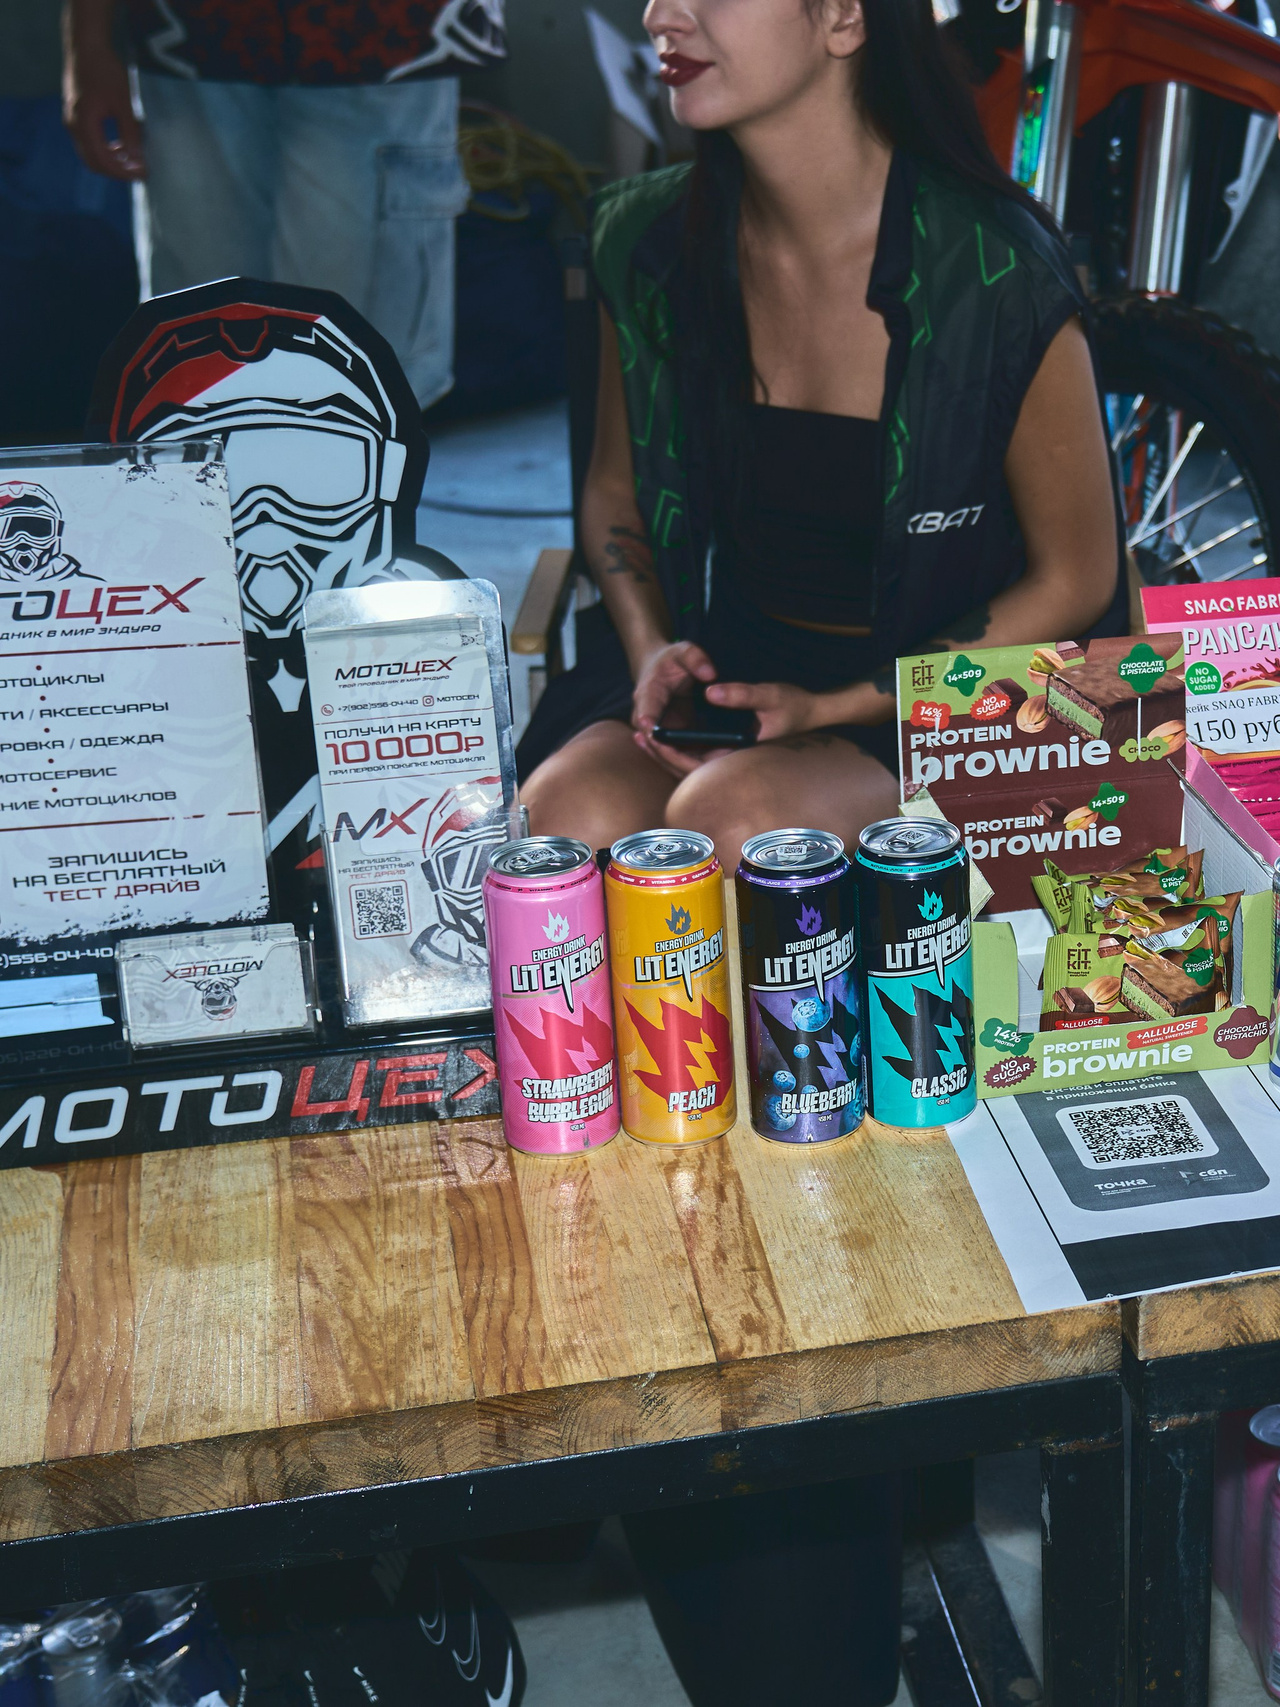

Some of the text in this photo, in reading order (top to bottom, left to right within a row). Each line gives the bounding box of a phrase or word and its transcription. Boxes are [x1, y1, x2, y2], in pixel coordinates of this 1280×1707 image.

[1184, 597, 1234, 615] SNAQ
[335, 656, 457, 681] МОТОЦЕХ
[912, 660, 934, 677] FIT
[1121, 660, 1164, 670] CHOCOLATE
[1127, 666, 1165, 675] PISTACHIO
[1195, 667, 1209, 676] NO
[912, 676, 934, 687] KIT
[1189, 675, 1218, 684] SUGAR
[40, 702, 169, 718] АКСЕССУАРЫ
[976, 700, 1007, 715] SUGAR
[983, 696, 997, 706] NO
[1211, 699, 1245, 712] SNAQ
[920, 706, 942, 717] 14%
[324, 717, 481, 740] ПОЛУЧИ НА КАРТУ
[910, 724, 1012, 750] PROTEIN
[1194, 718, 1236, 743] 150
[80, 733, 164, 748] ОДЕЖДА
[911, 736, 1111, 785] brownie
[0, 791, 177, 811] НИЕ МОТОЦИКЛОВ
[964, 815, 1045, 835] PROTEIN
[966, 823, 1122, 860] brownie
[48, 848, 188, 868] ЗАПИШИСЬ
[13, 859, 226, 888] НА БЕСПЛАТНЫЙ
[43, 879, 200, 902] ТЕСТ ДРАЙВ
[907, 913, 956, 940] ENERGY DRINK
[532, 934, 586, 962] ENERGY DRINK
[655, 928, 704, 953] ENERGY DRINK
[785, 927, 837, 955] ENERGY DRINK
[917, 912, 971, 990] ENERGY
[1067, 942, 1091, 960] FIT
[541, 932, 604, 1012] ENERGY
[664, 927, 723, 1002] ENERGY
[795, 926, 854, 1002] ENERGY
[1067, 961, 1091, 970] KIT
[994, 1026, 1021, 1043] 14%
[1043, 1020, 1198, 1055] PROTEIN +ALLULOSE
[1217, 1021, 1267, 1035] CHOCOLATE
[1224, 1028, 1268, 1041] PISTACHIO
[994, 1038, 1015, 1048] PROTEIN
[1000, 1060, 1018, 1072] NO
[1043, 1043, 1193, 1079] brownie
[521, 1058, 613, 1099] STRAWBERRY
[910, 1067, 968, 1098] CLASSIC
[992, 1063, 1031, 1083] SUGAR
[1005, 1074, 1022, 1083] ADDED
[1105, 1076, 1163, 1087] оплатите
[527, 1084, 614, 1123] BUBBLEGUM
[668, 1084, 717, 1113] PEACH
[781, 1078, 857, 1114] BLUEBERRY
[1094, 1168, 1229, 1190] точка сбп
